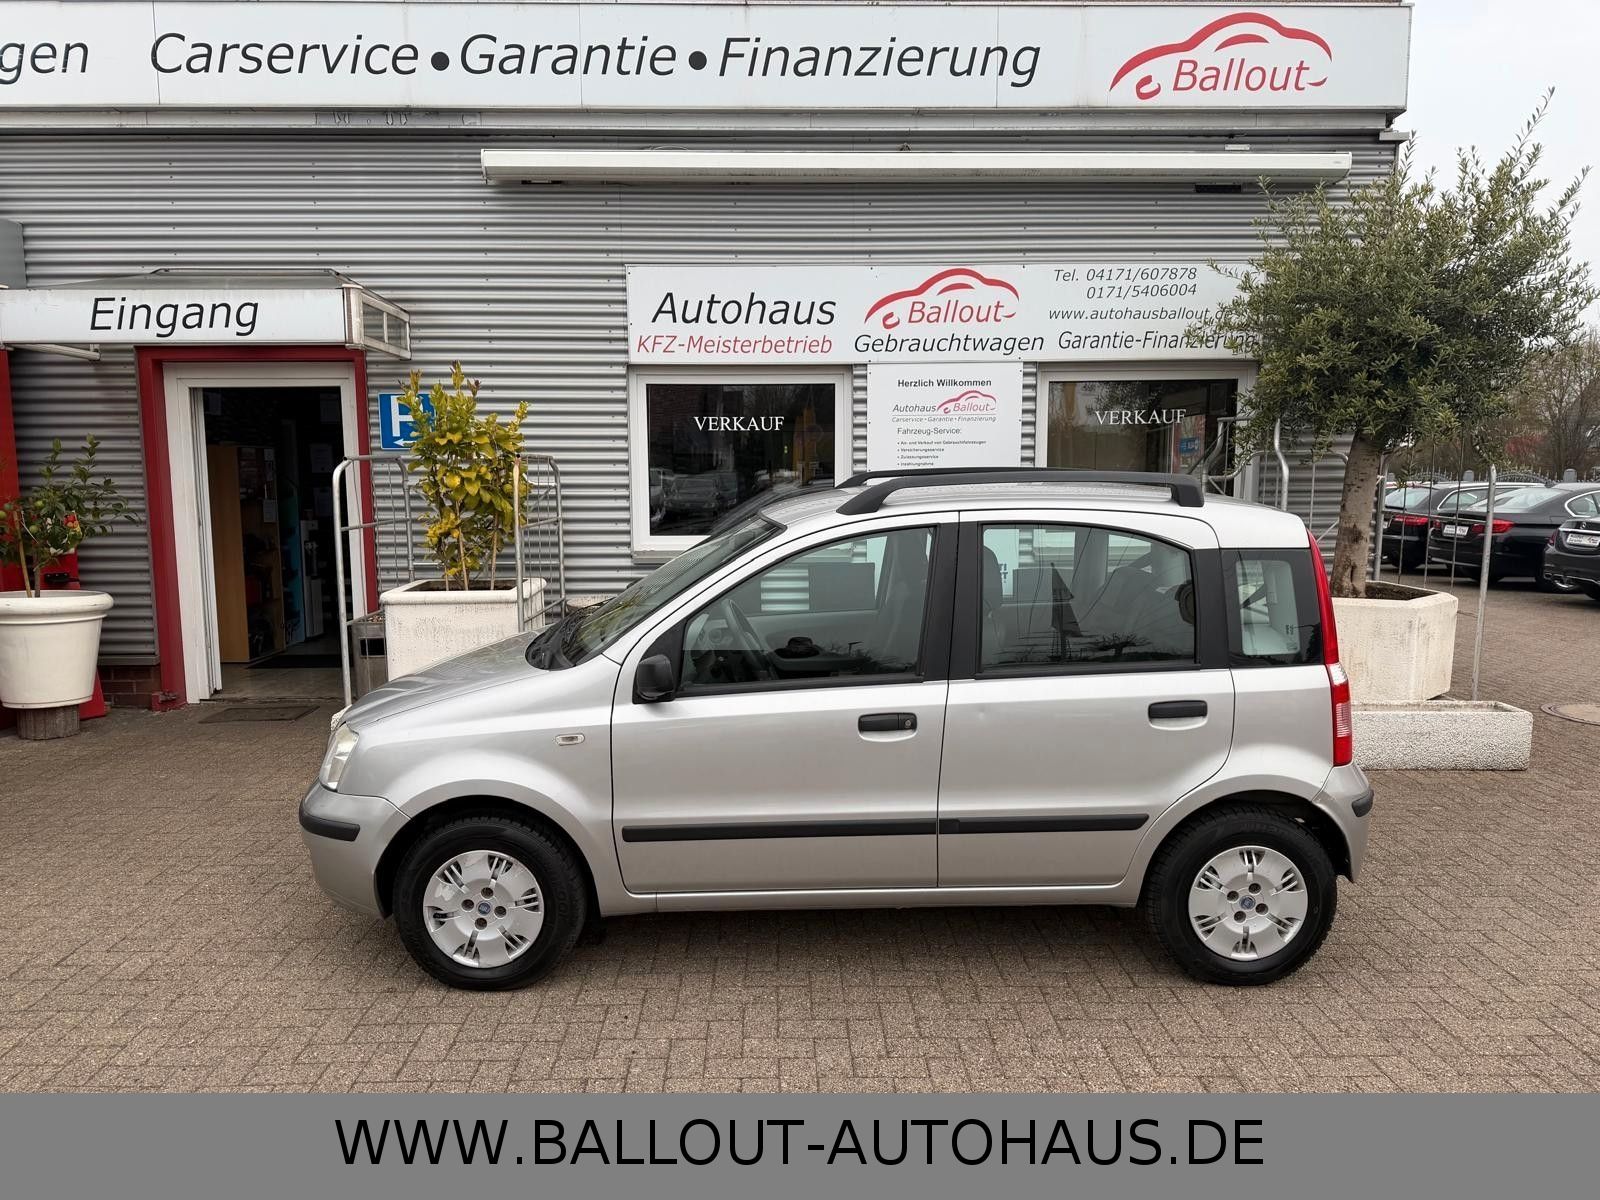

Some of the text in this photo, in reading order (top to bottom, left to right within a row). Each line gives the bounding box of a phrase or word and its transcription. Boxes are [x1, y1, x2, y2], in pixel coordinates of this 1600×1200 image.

[150, 33, 1041, 88] Carservice Garantie Finanzierung
[1172, 58, 1310, 92] Ballout
[1054, 267, 1197, 283] Tel. 04171/607878
[1086, 283, 1197, 300] 0171/5406004
[90, 297, 259, 338] Eingang
[651, 291, 837, 325] Autohaus
[907, 299, 1004, 324] Ballout
[637, 334, 833, 354] KFZ-Meisterbetrieb
[854, 333, 1044, 356] Gebrauchtwagen
[897, 379, 992, 388] Herzlich Willkommen
[892, 402, 991, 413] Autohaus Ballout
[1095, 409, 1187, 425] VERKAUF
[693, 416, 785, 431] VERKAUF
